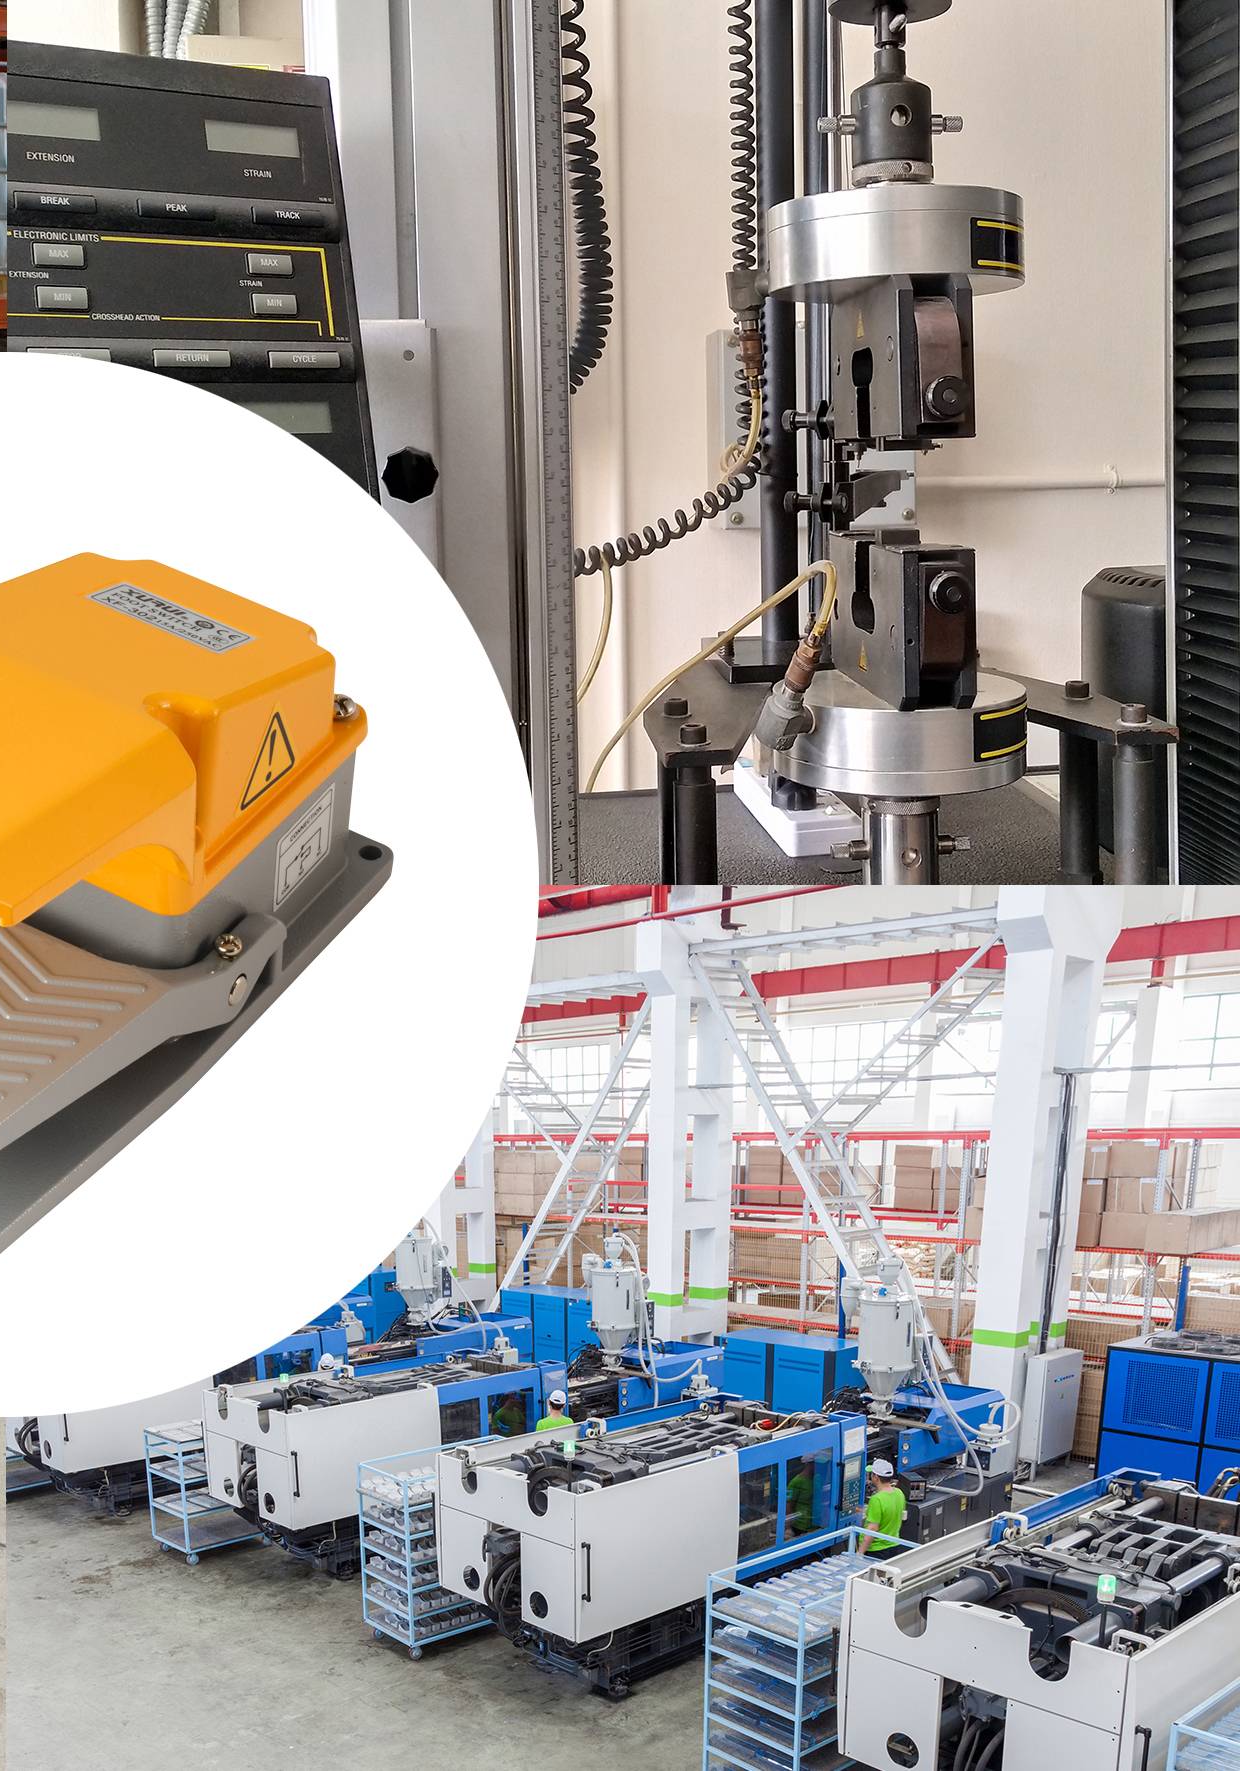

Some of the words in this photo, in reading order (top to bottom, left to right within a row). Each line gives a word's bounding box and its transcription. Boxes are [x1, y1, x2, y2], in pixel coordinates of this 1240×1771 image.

[26, 151, 75, 163] EXTENSION
[243, 168, 272, 179] STRAIN
[40, 196, 70, 206] BREAK
[165, 202, 188, 214] PEAK
[275, 210, 300, 220] TRACK
[13, 230, 68, 241] ELECTRONIC
[70, 233, 100, 242] LIMITS
[48, 249, 69, 258] MAX
[260, 258, 278, 267] MAX
[8, 270, 49, 279] EXTENSION
[239, 279, 263, 287] STRAIN
[53, 292, 72, 301] MIN
[266, 298, 282, 307] MIN
[91, 313, 134, 321] CROSSHEAD
[135, 314, 160, 322] ACTION
[176, 353, 209, 362] RETURN
[292, 354, 317, 363] CYCLE
[112, 592, 147, 611] FOOT
[149, 608, 202, 632] SWITCH
